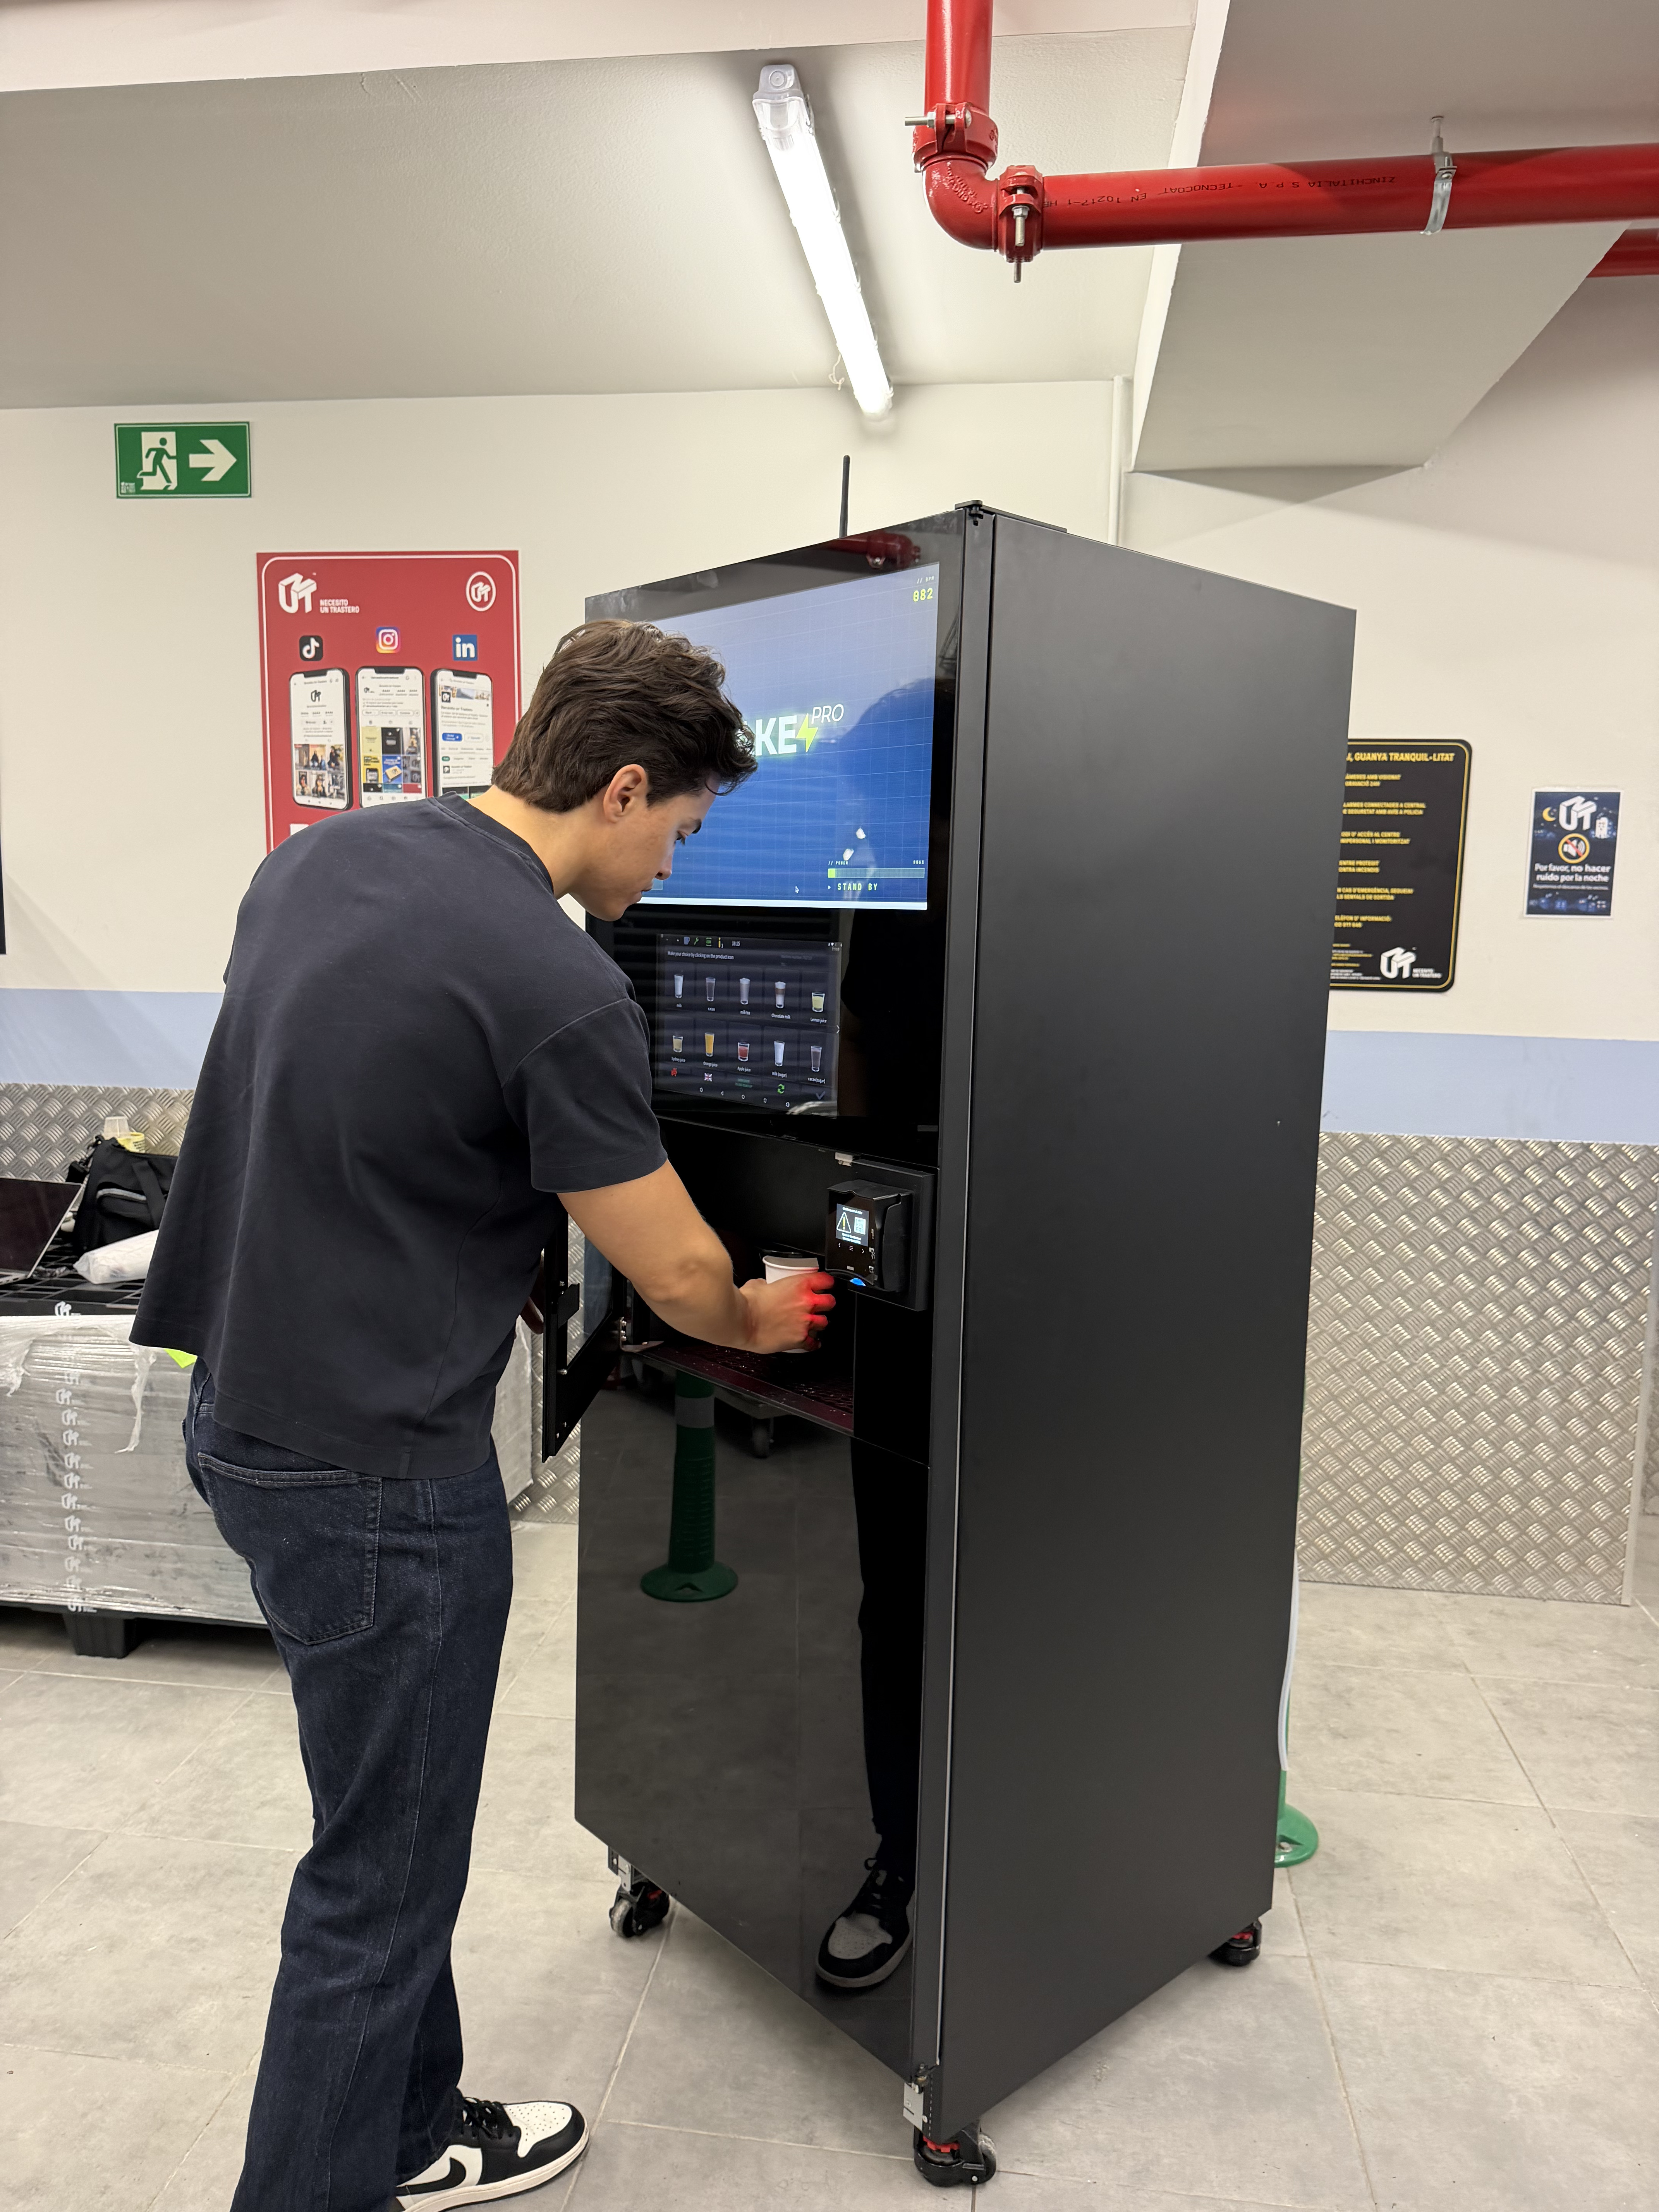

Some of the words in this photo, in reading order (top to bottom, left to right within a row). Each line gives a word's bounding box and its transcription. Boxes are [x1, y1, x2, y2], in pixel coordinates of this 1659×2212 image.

[1163, 182, 1232, 194] TECNOCOAT
[1131, 193, 1147, 202] EN
[455, 637, 475, 658] in
[811, 703, 844, 725] PRO
[754, 715, 797, 756] KE
[1354, 752, 1388, 761] GUANYA
[1534, 863, 1548, 871] Por
[1549, 863, 1570, 872] favor,
[1585, 864, 1612, 873] hacer
[1560, 874, 1575, 883] por
[1575, 873, 1582, 882] la
[1583, 874, 1609, 883] noche
